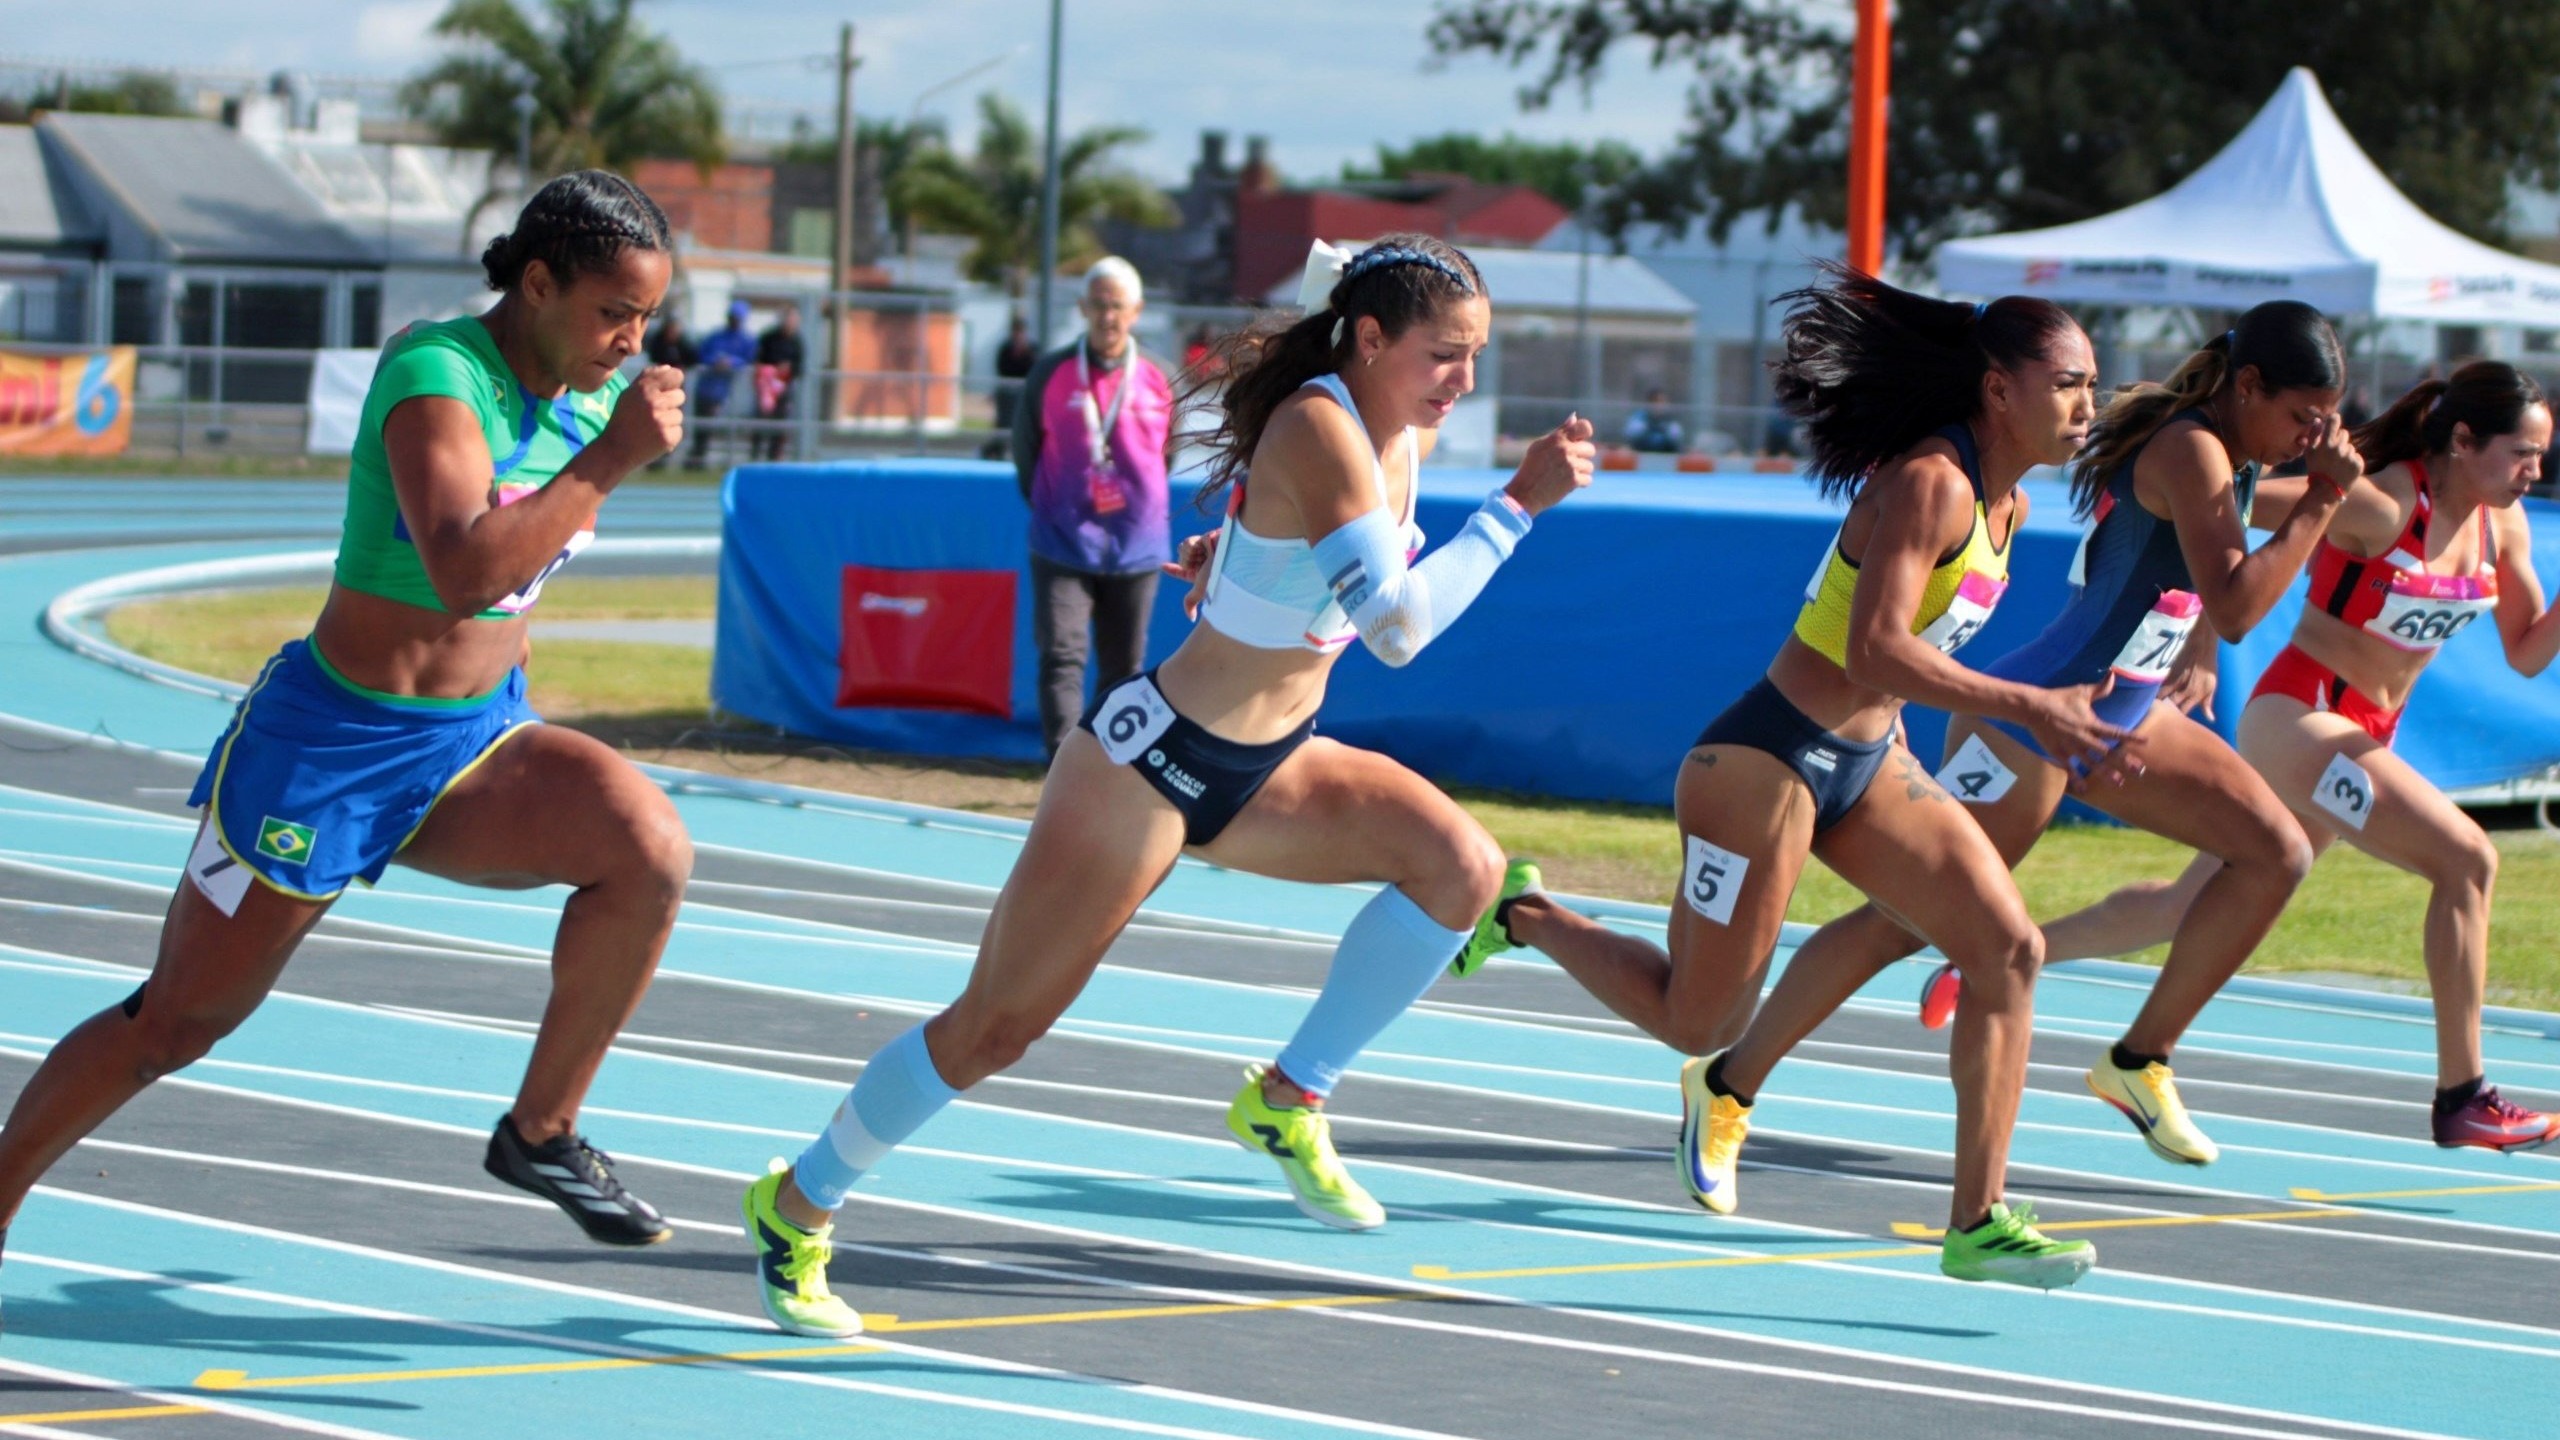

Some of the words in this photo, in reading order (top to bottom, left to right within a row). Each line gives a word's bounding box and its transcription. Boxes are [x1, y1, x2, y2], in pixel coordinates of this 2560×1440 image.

[75, 354, 121, 434] 6
[1108, 705, 1148, 744] 6
[1161, 769, 1202, 800] SEGUROS
[1168, 762, 1207, 793] SANCOR
[1956, 769, 1993, 798] 4
[2333, 776, 2366, 813] 3
[1692, 861, 1726, 902] 5
